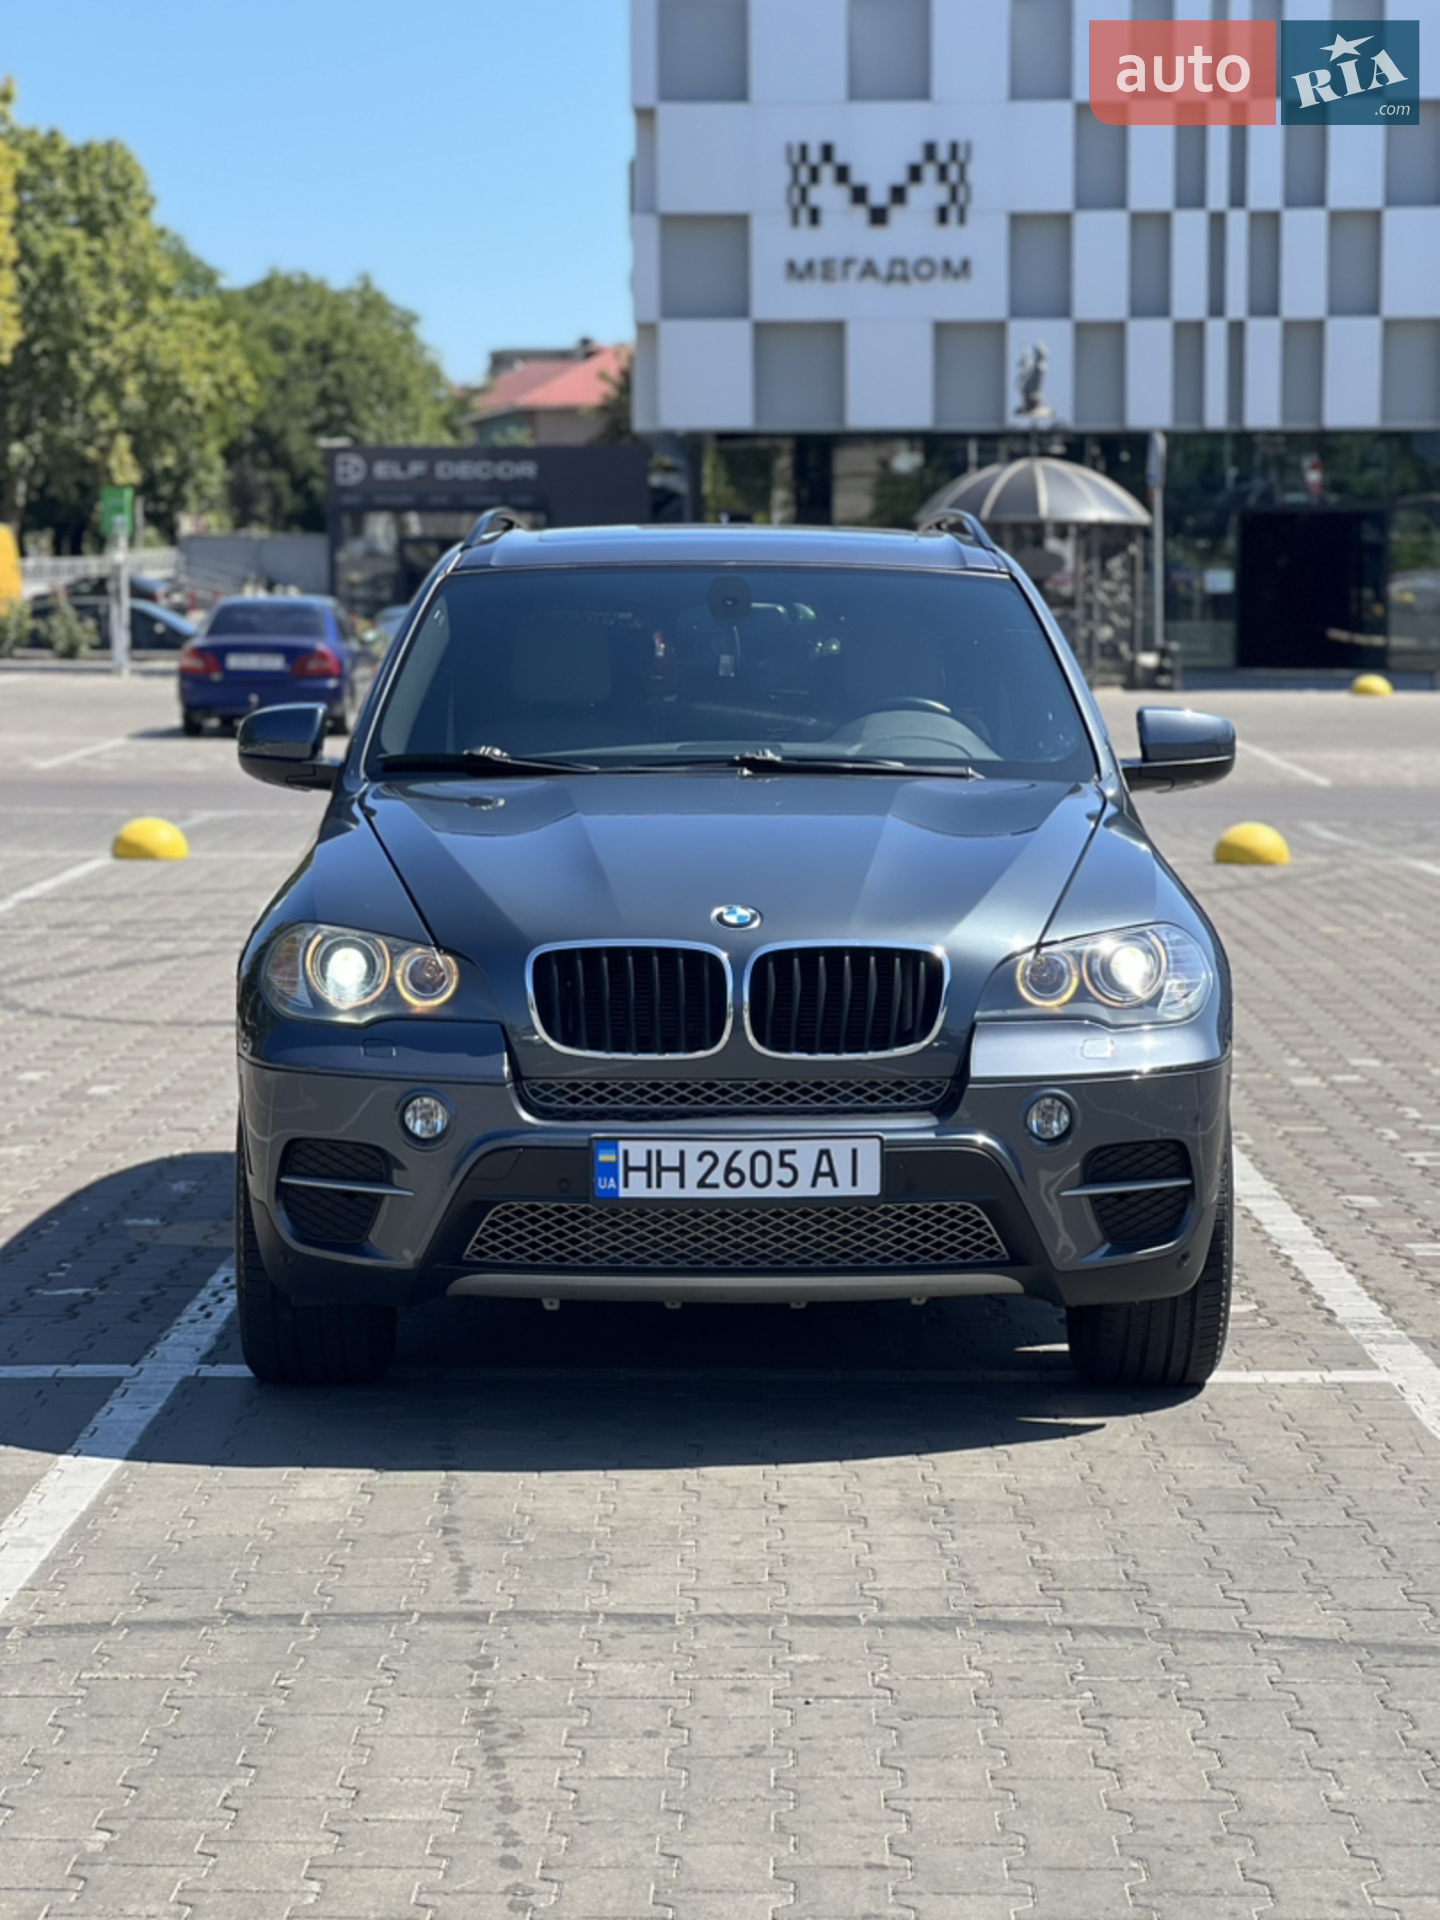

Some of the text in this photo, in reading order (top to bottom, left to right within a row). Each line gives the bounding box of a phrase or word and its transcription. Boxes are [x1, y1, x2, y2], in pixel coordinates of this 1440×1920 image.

[786, 257, 972, 285] МЕГАДОМ
[372, 459, 540, 481] ELF DECOR
[622, 1147, 859, 1189] HH 2605 AI
[598, 1177, 617, 1189] UA
